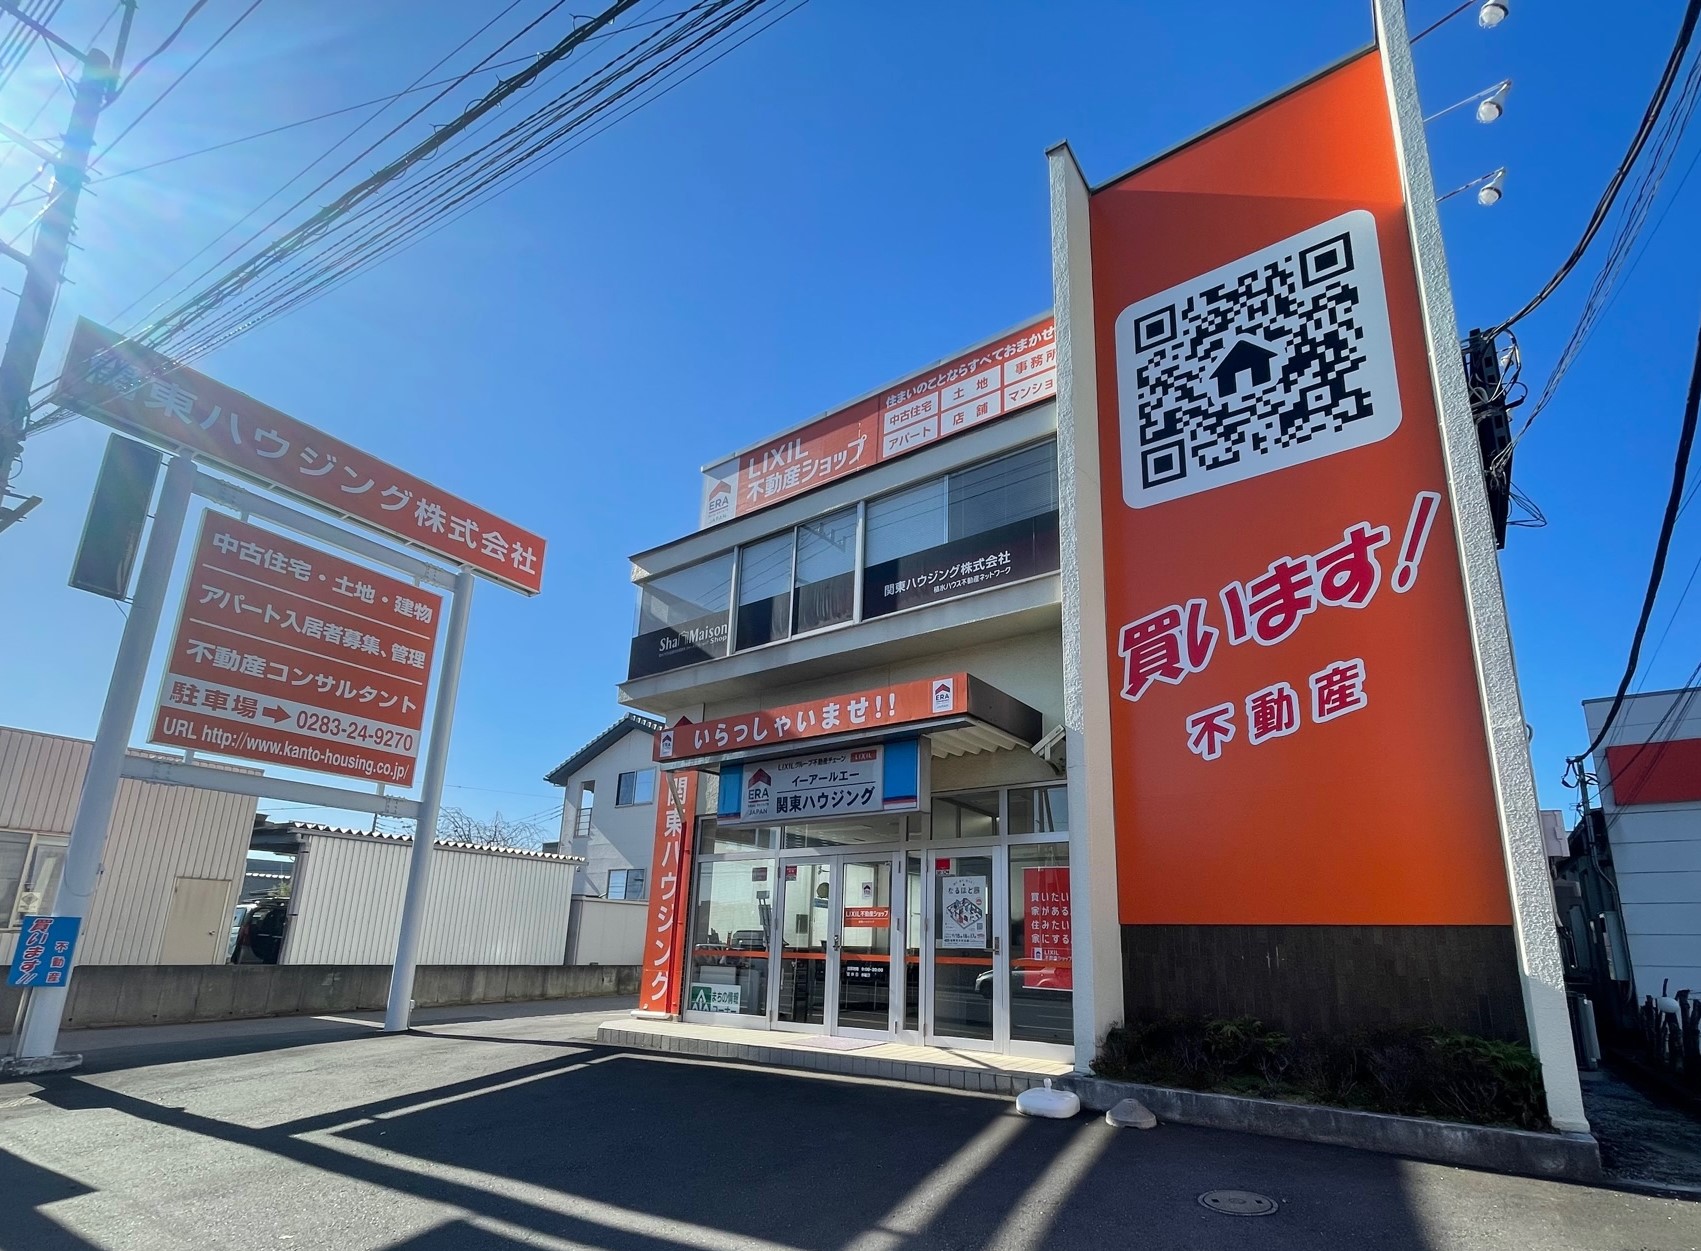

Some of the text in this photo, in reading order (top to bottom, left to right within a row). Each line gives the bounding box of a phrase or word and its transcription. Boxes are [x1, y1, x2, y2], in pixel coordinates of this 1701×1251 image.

[953, 376, 989, 400] 土地
[889, 400, 933, 426] 中古住宅
[952, 402, 988, 426] 店舗
[889, 426, 931, 450] アパート
[746, 434, 868, 502] 不動産ショップ
[748, 437, 809, 480] LIXIL
[708, 496, 729, 511] ERA
[212, 532, 433, 624] 中古住宅・土地・建物
[884, 550, 1011, 597] 関東ハウジング株式会社
[1118, 491, 1441, 701] 買います!
[199, 584, 427, 670] アパート入居者募集、管理
[688, 623, 728, 644] Maison
[709, 635, 728, 645] Shop
[187, 639, 417, 714] 不動産コンサルタント
[168, 680, 414, 752] 駐車場 0283-24-9270
[694, 692, 896, 750] いらっしゃいませ!!
[1187, 658, 1367, 760] 不動産
[163, 715, 410, 780] URL http://www.kanto-housing.co.jp/
[854, 752, 873, 760] LIXIL
[792, 771, 860, 787] イーアールエー
[748, 788, 770, 800] ERA
[776, 786, 876, 814] 関東ハウジング
[748, 808, 768, 816] JAPAN
[1031, 892, 1069, 902] 買いたい
[1031, 906, 1071, 916] 家がある
[1031, 920, 1070, 930] 住みたい
[1031, 934, 1072, 944] 家にする
